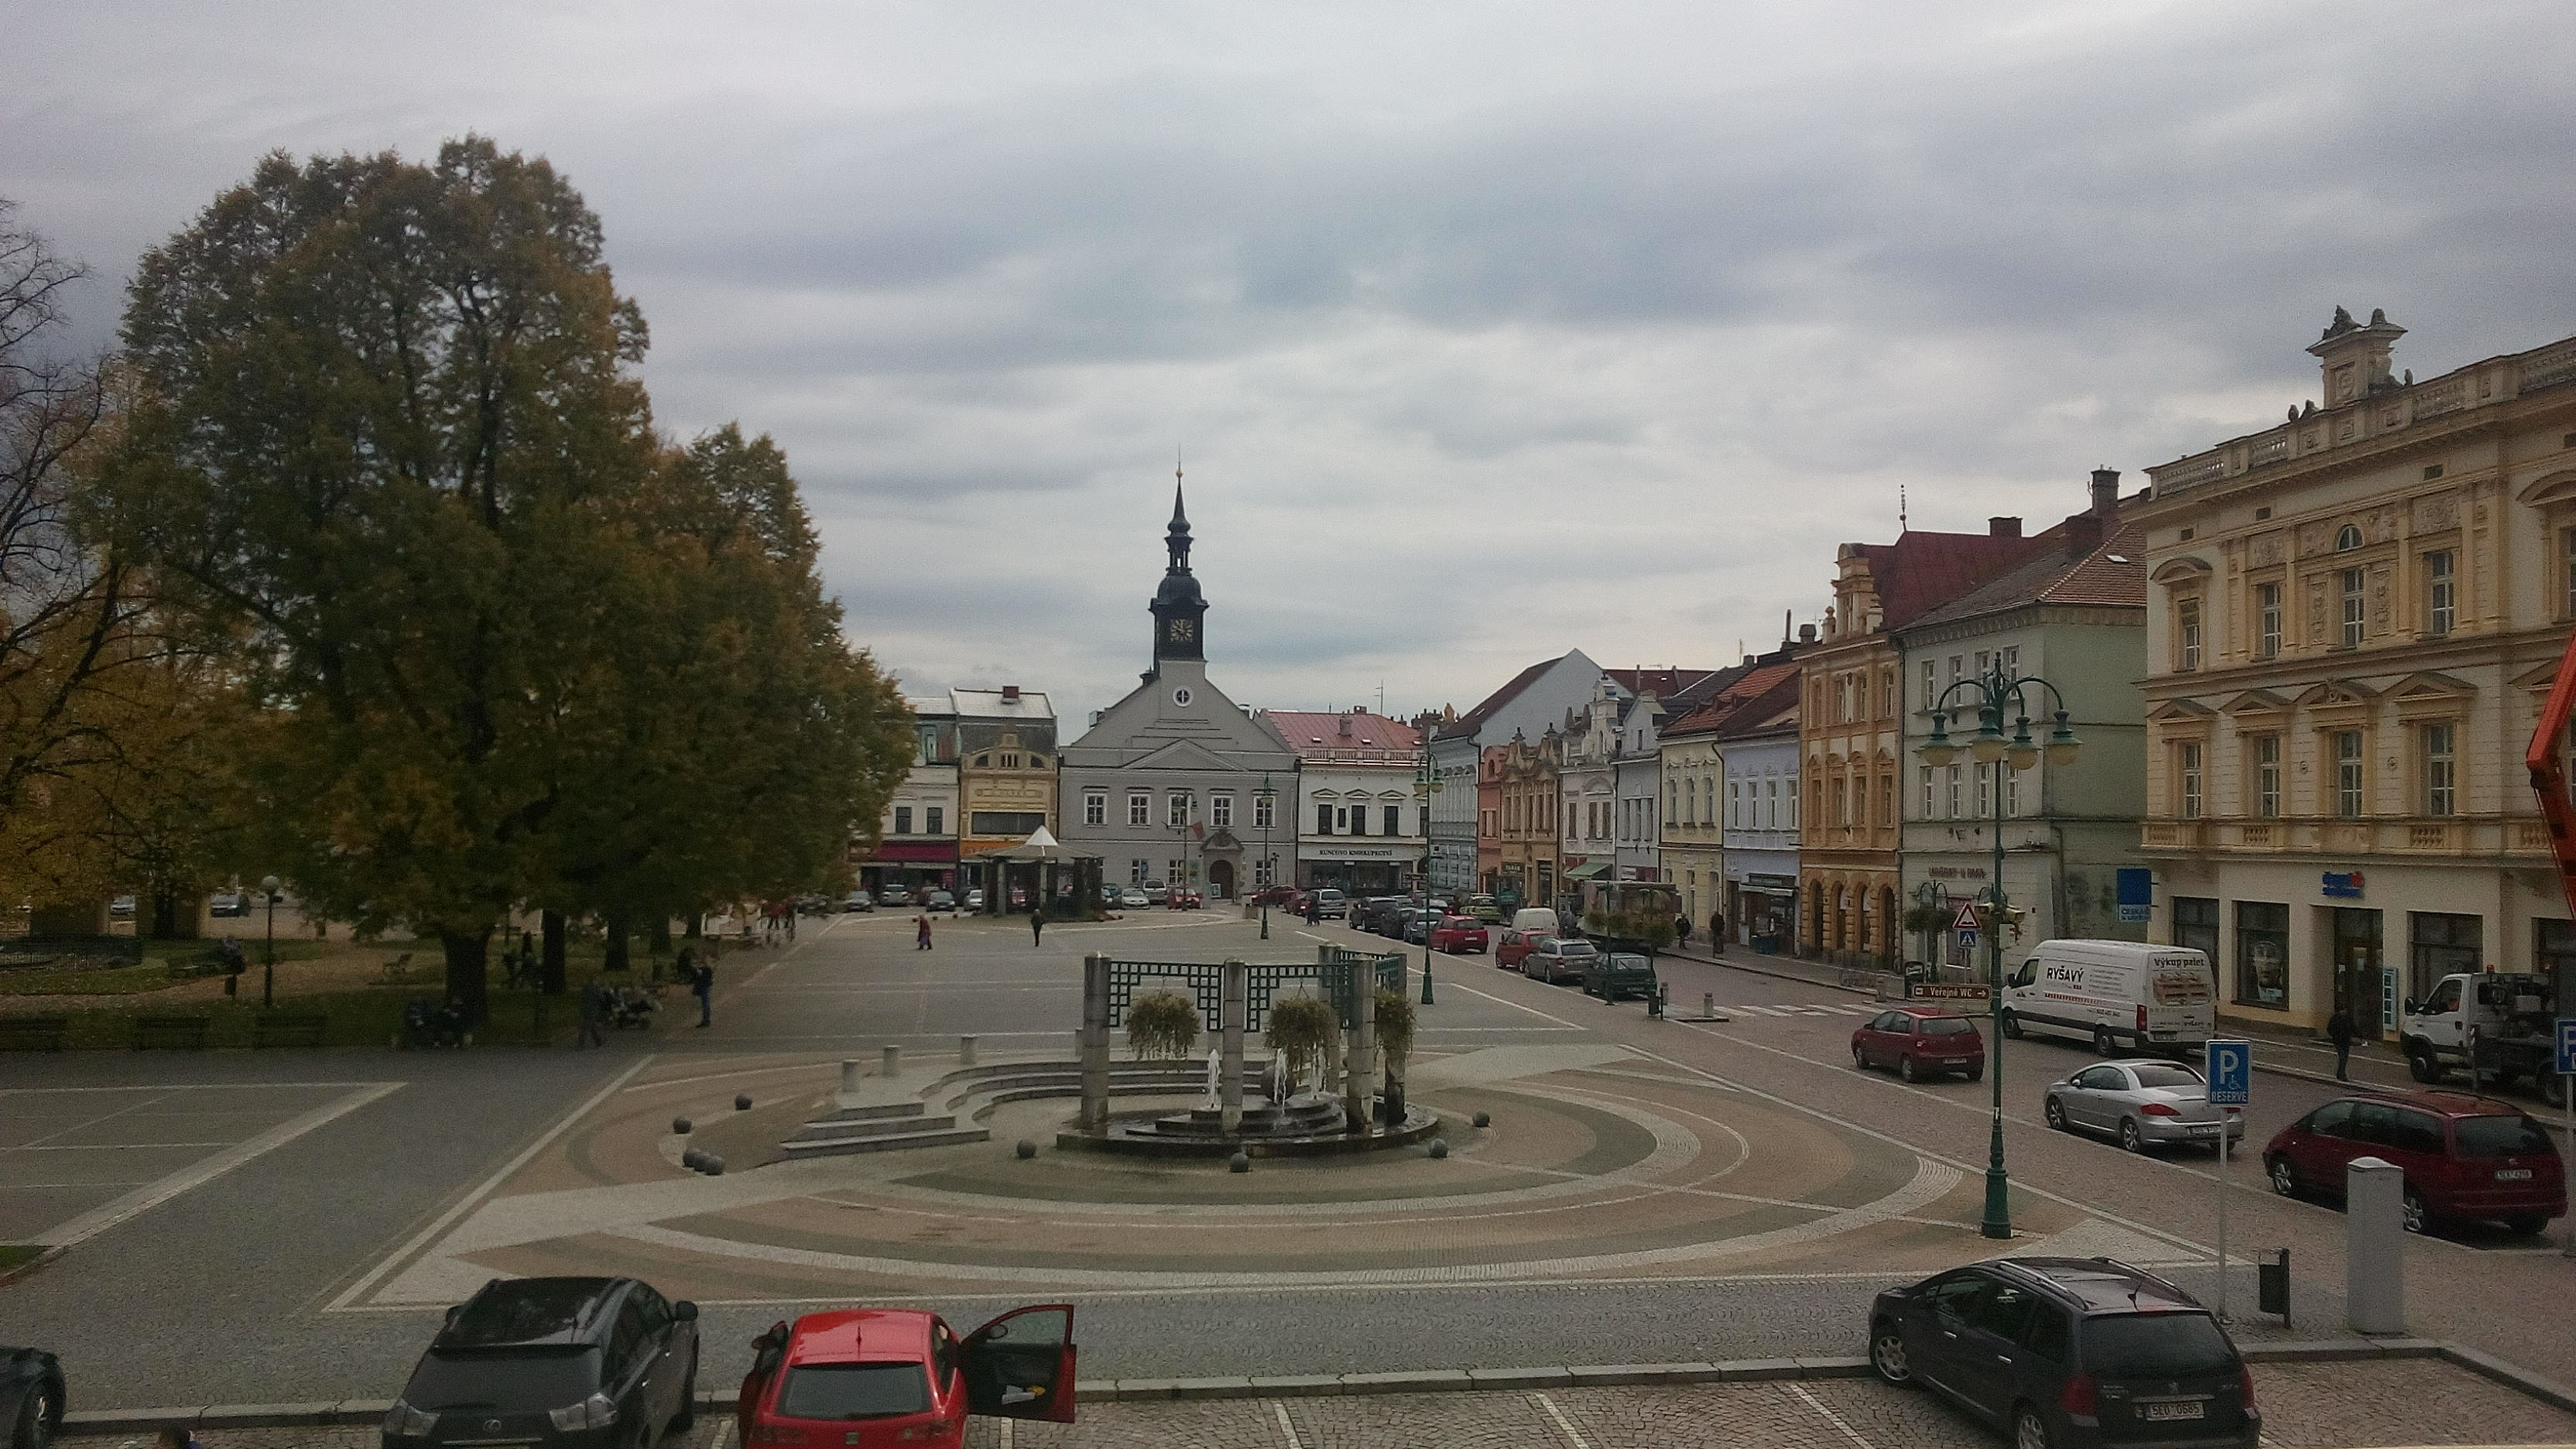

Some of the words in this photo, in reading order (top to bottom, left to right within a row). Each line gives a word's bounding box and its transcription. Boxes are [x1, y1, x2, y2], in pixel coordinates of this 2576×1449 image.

[2154, 957, 2181, 968] Výkup
[2183, 958, 2205, 968] palet
[2047, 964, 2084, 983] RYŠAVÝ
[1930, 987, 1958, 999] Veřejné
[1960, 988, 1972, 997] WC
[2219, 1050, 2239, 1084] P
